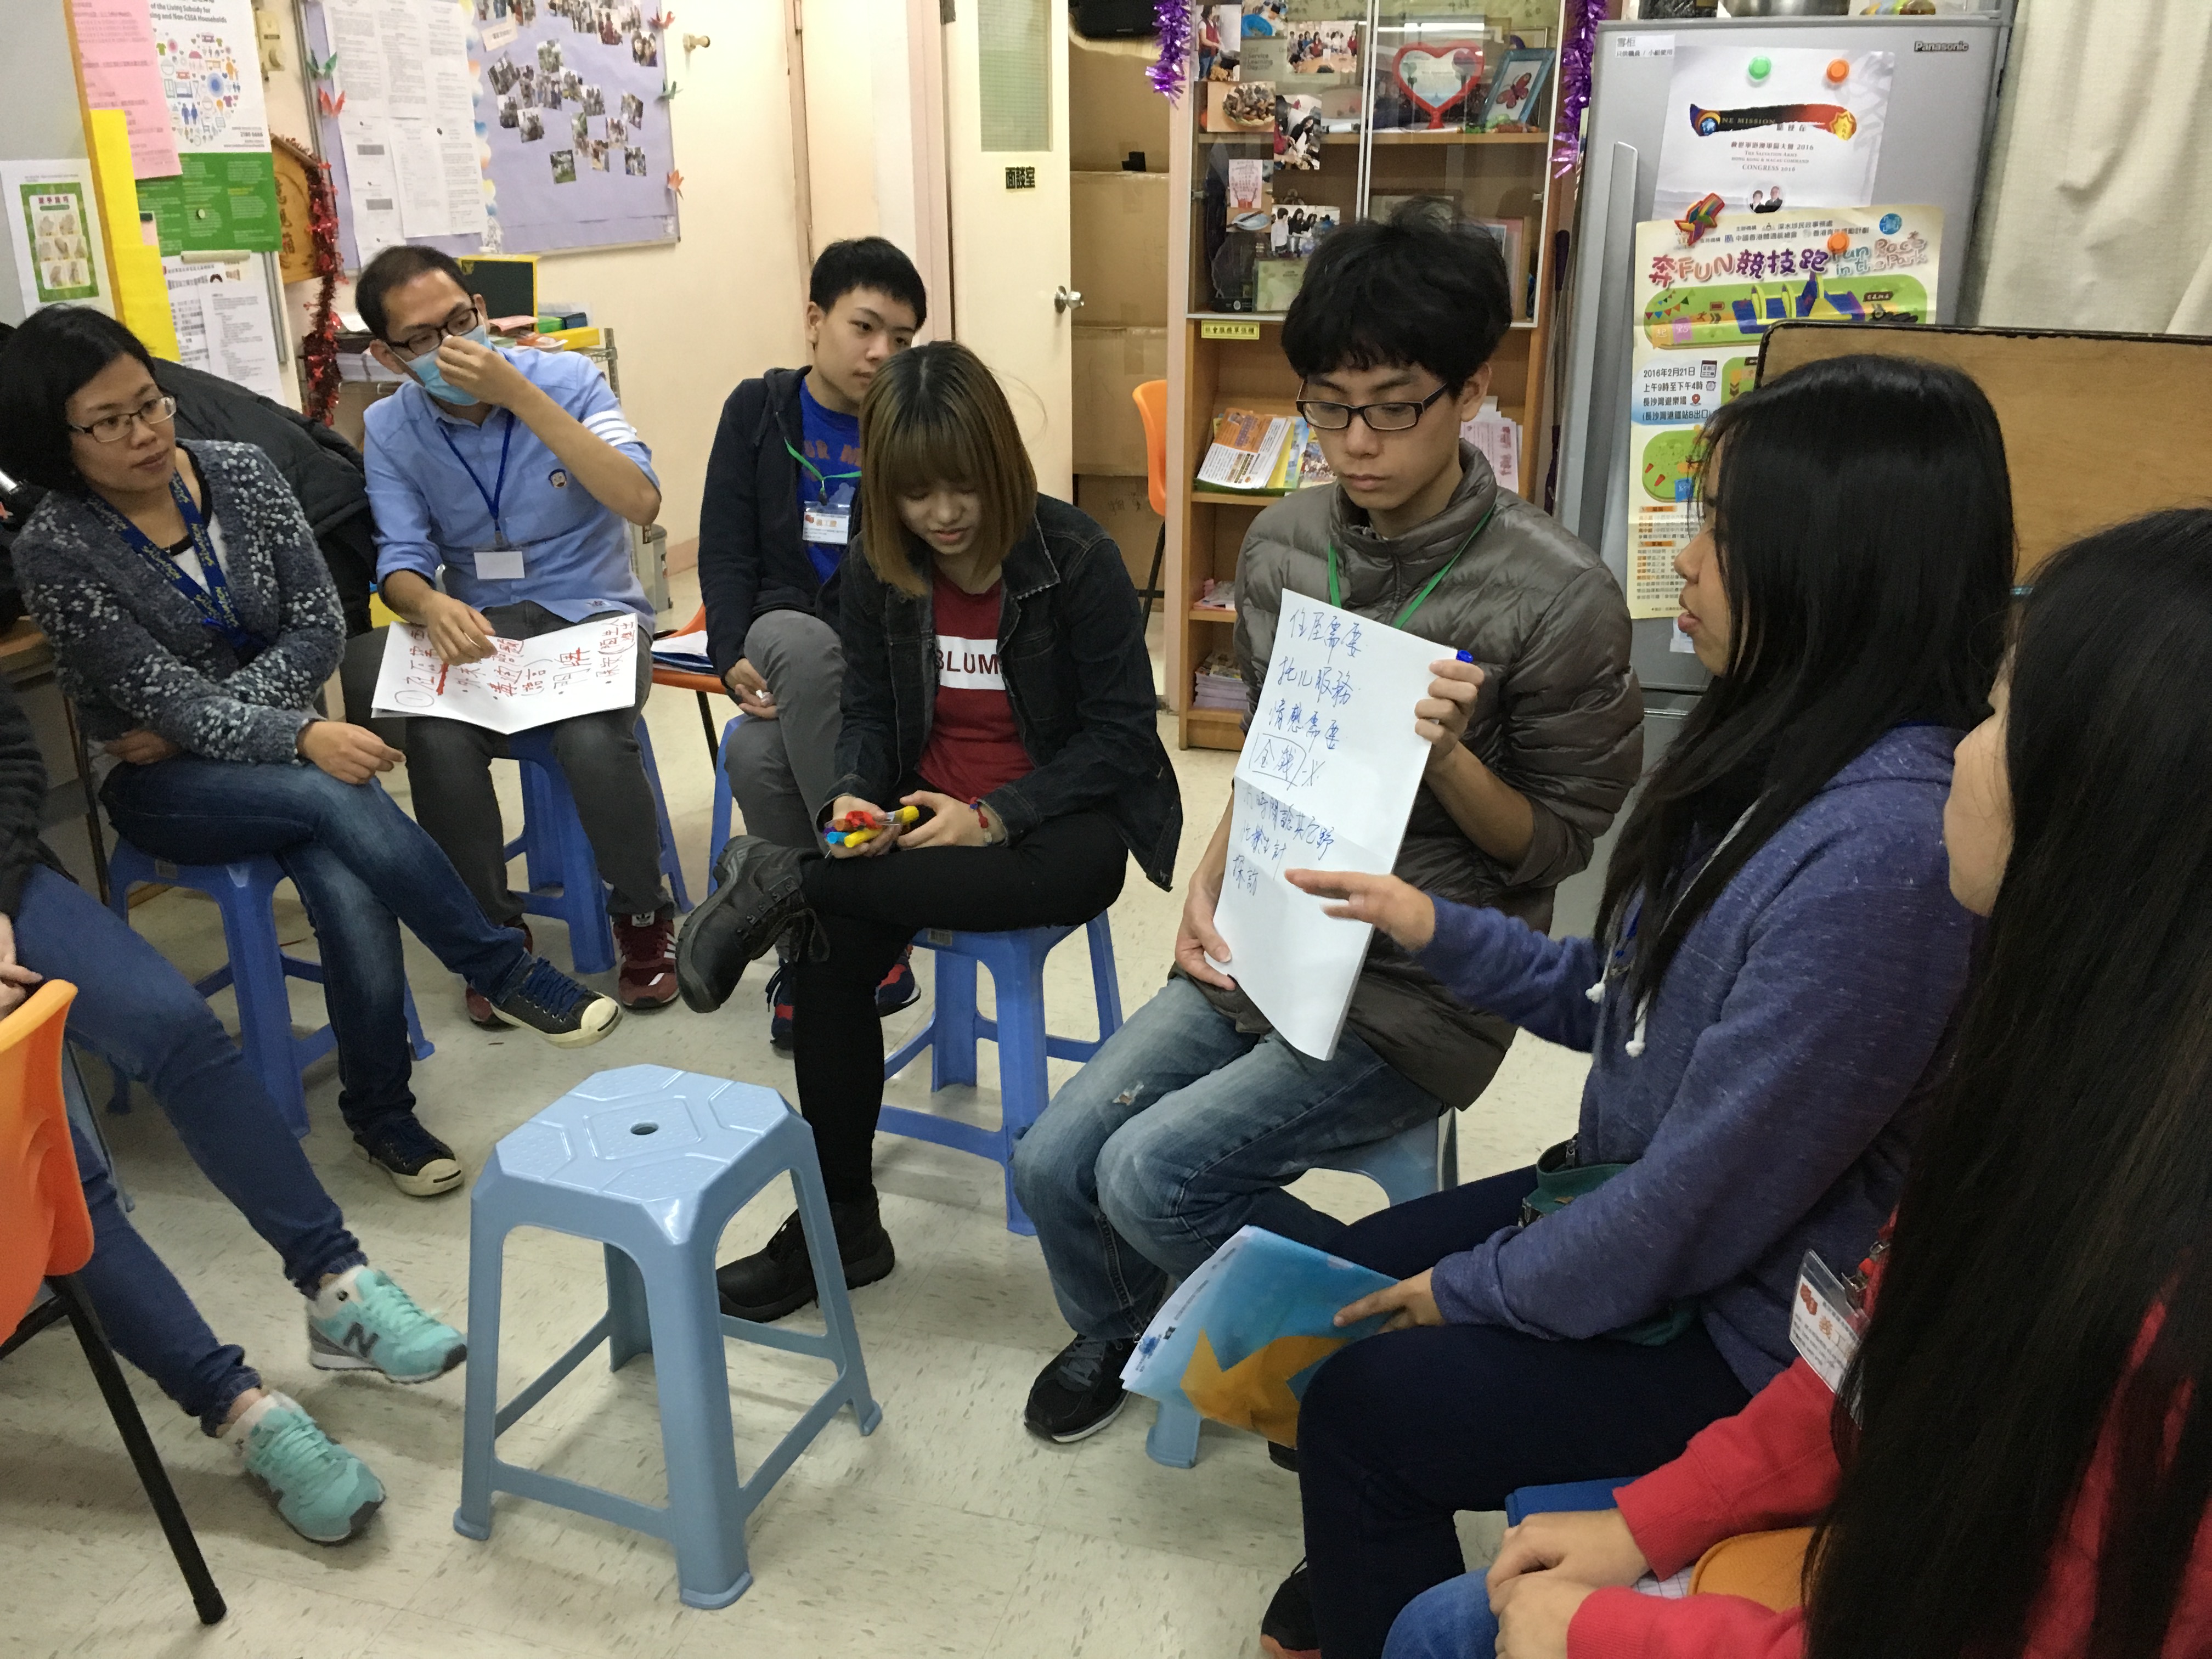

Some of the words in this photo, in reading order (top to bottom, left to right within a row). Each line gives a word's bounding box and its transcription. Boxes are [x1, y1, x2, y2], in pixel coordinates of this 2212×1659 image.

[167, 4, 182, 12] Living
[1914, 41, 1969, 52] Panasonic
[1005, 166, 1035, 189] 面談室
[1643, 366, 1695, 378] 2016年2月21日
[1643, 381, 1703, 393] 上午9時至下午4時
